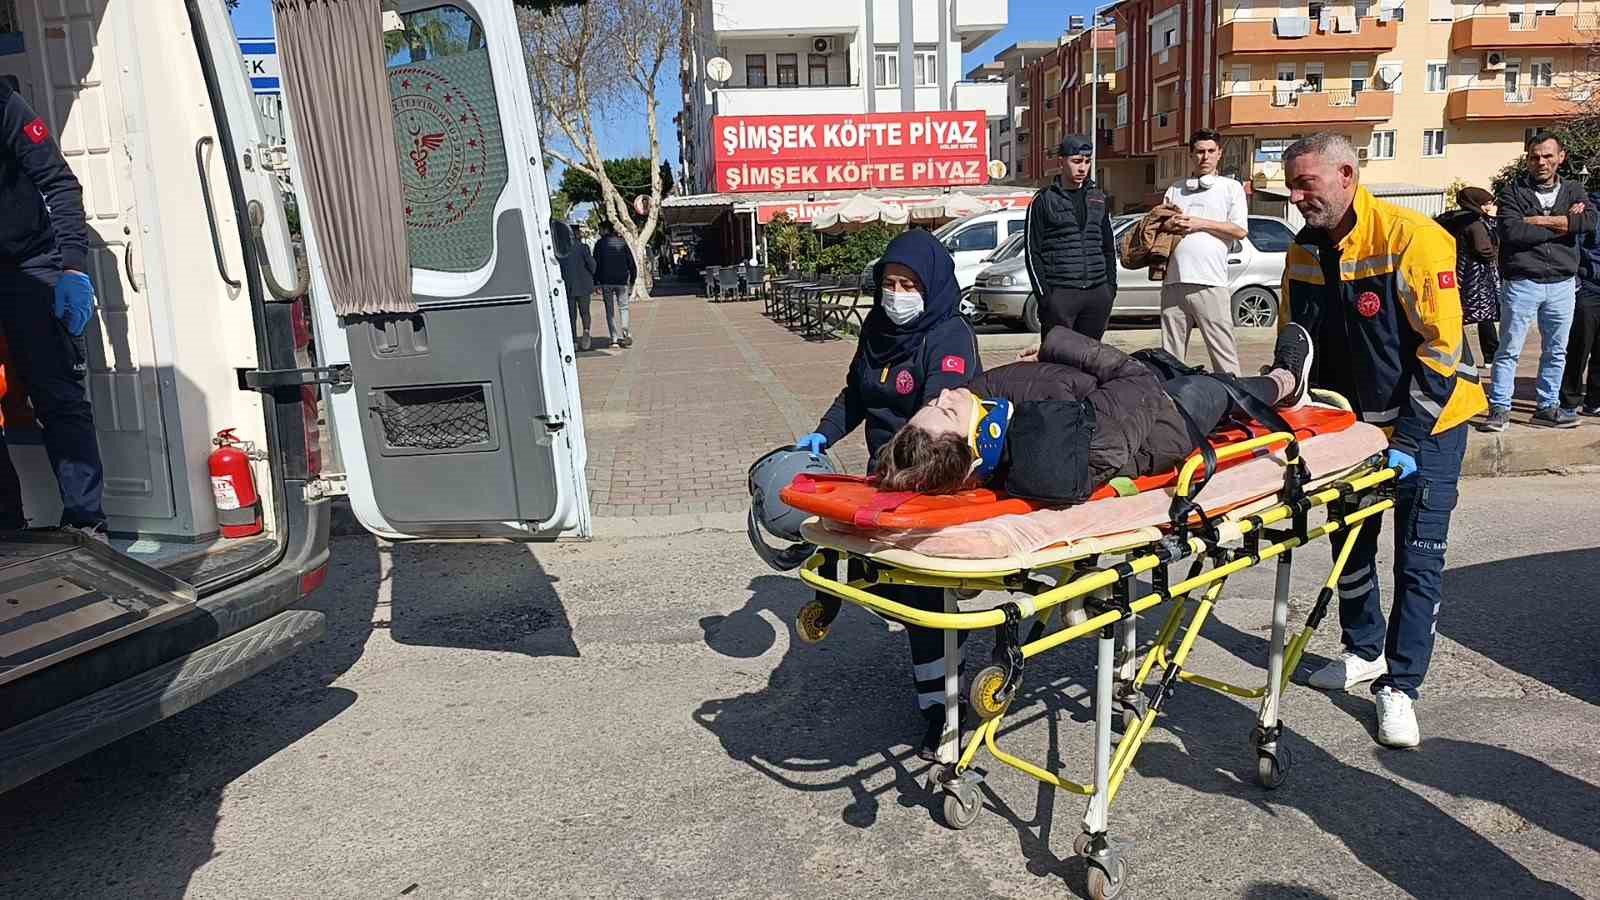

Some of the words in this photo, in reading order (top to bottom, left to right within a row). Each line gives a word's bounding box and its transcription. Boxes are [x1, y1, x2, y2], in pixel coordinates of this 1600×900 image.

[723, 120, 815, 155] ŞİMŞEK
[823, 119, 902, 149] KÖFTE
[910, 116, 978, 145] PİYAZ
[726, 160, 819, 190] ŞİMŞEK
[826, 161, 905, 184] KÖFTE
[912, 157, 981, 180] PİYAZ
